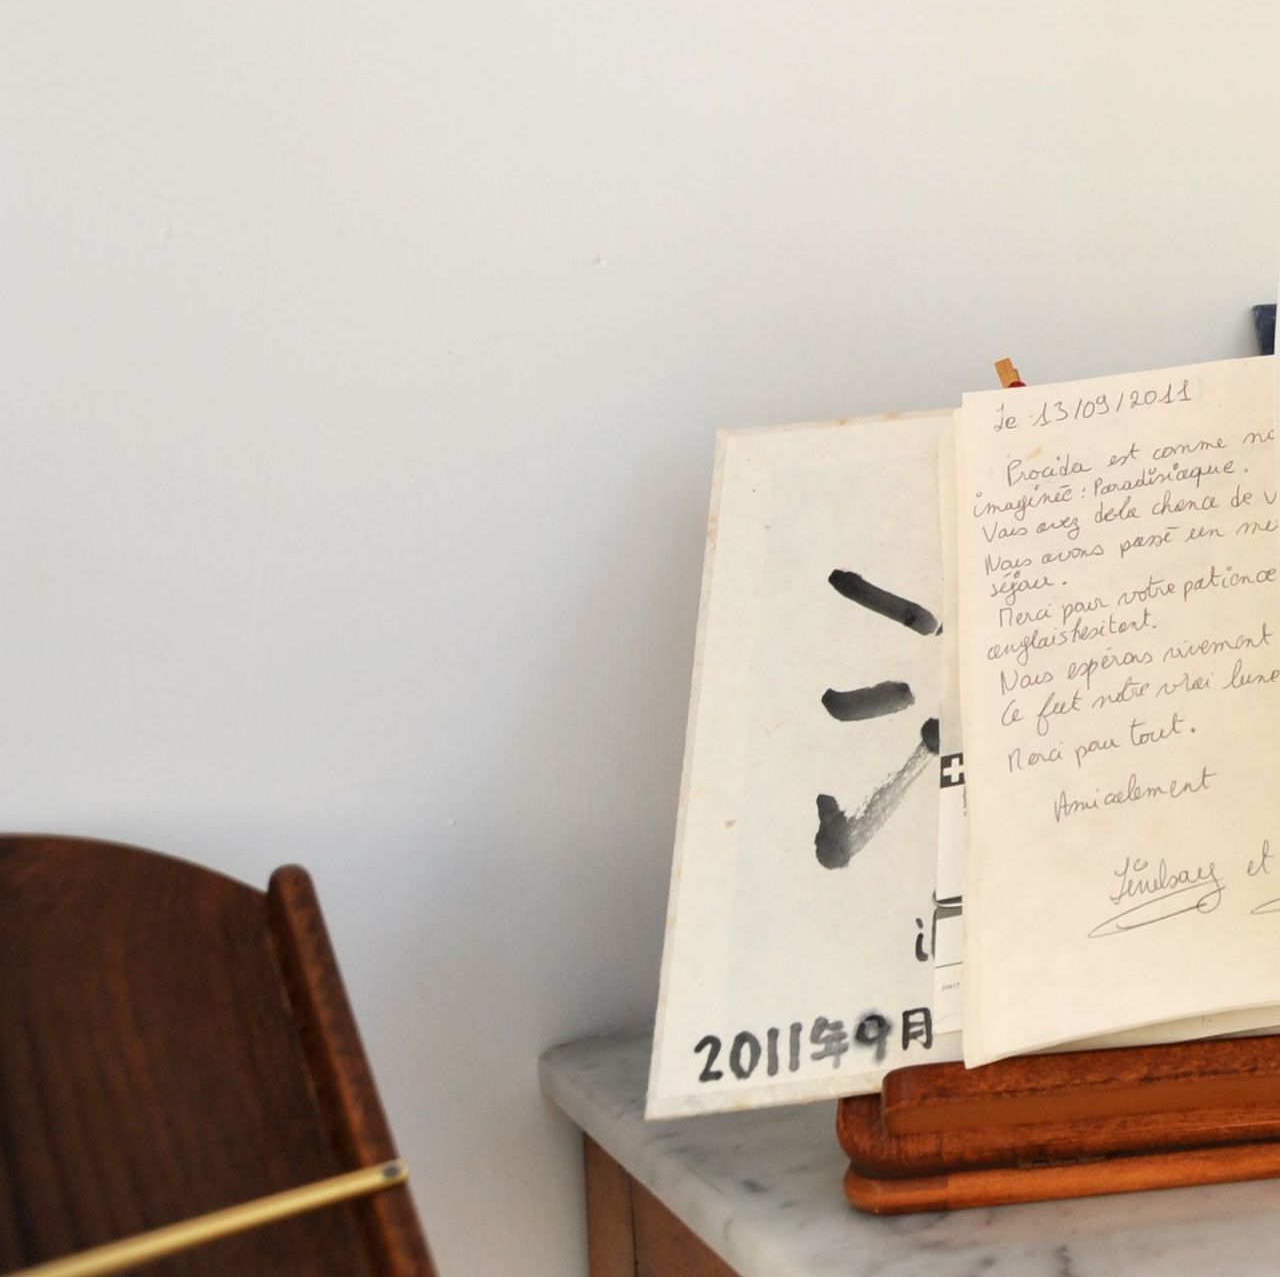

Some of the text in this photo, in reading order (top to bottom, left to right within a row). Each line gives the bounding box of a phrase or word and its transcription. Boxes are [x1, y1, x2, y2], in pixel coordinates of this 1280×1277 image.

[1031, 379, 1192, 427] 13/09/2011
[1007, 453, 1092, 487] Procida
[1107, 443, 1141, 467] est
[1152, 438, 1226, 461] comme
[1036, 516, 1080, 540] avez
[1230, 484, 1254, 508] de
[984, 554, 1032, 576] Nous
[1041, 544, 1104, 565] avons
[999, 603, 1052, 627] Merci
[1062, 598, 1108, 625] pour
[1118, 576, 1176, 605] votre
[1000, 670, 1054, 695] Nous
[1091, 676, 1150, 709] notre
[1247, 840, 1275, 876] et
[694, 1007, 934, 1083] 2011年9月
